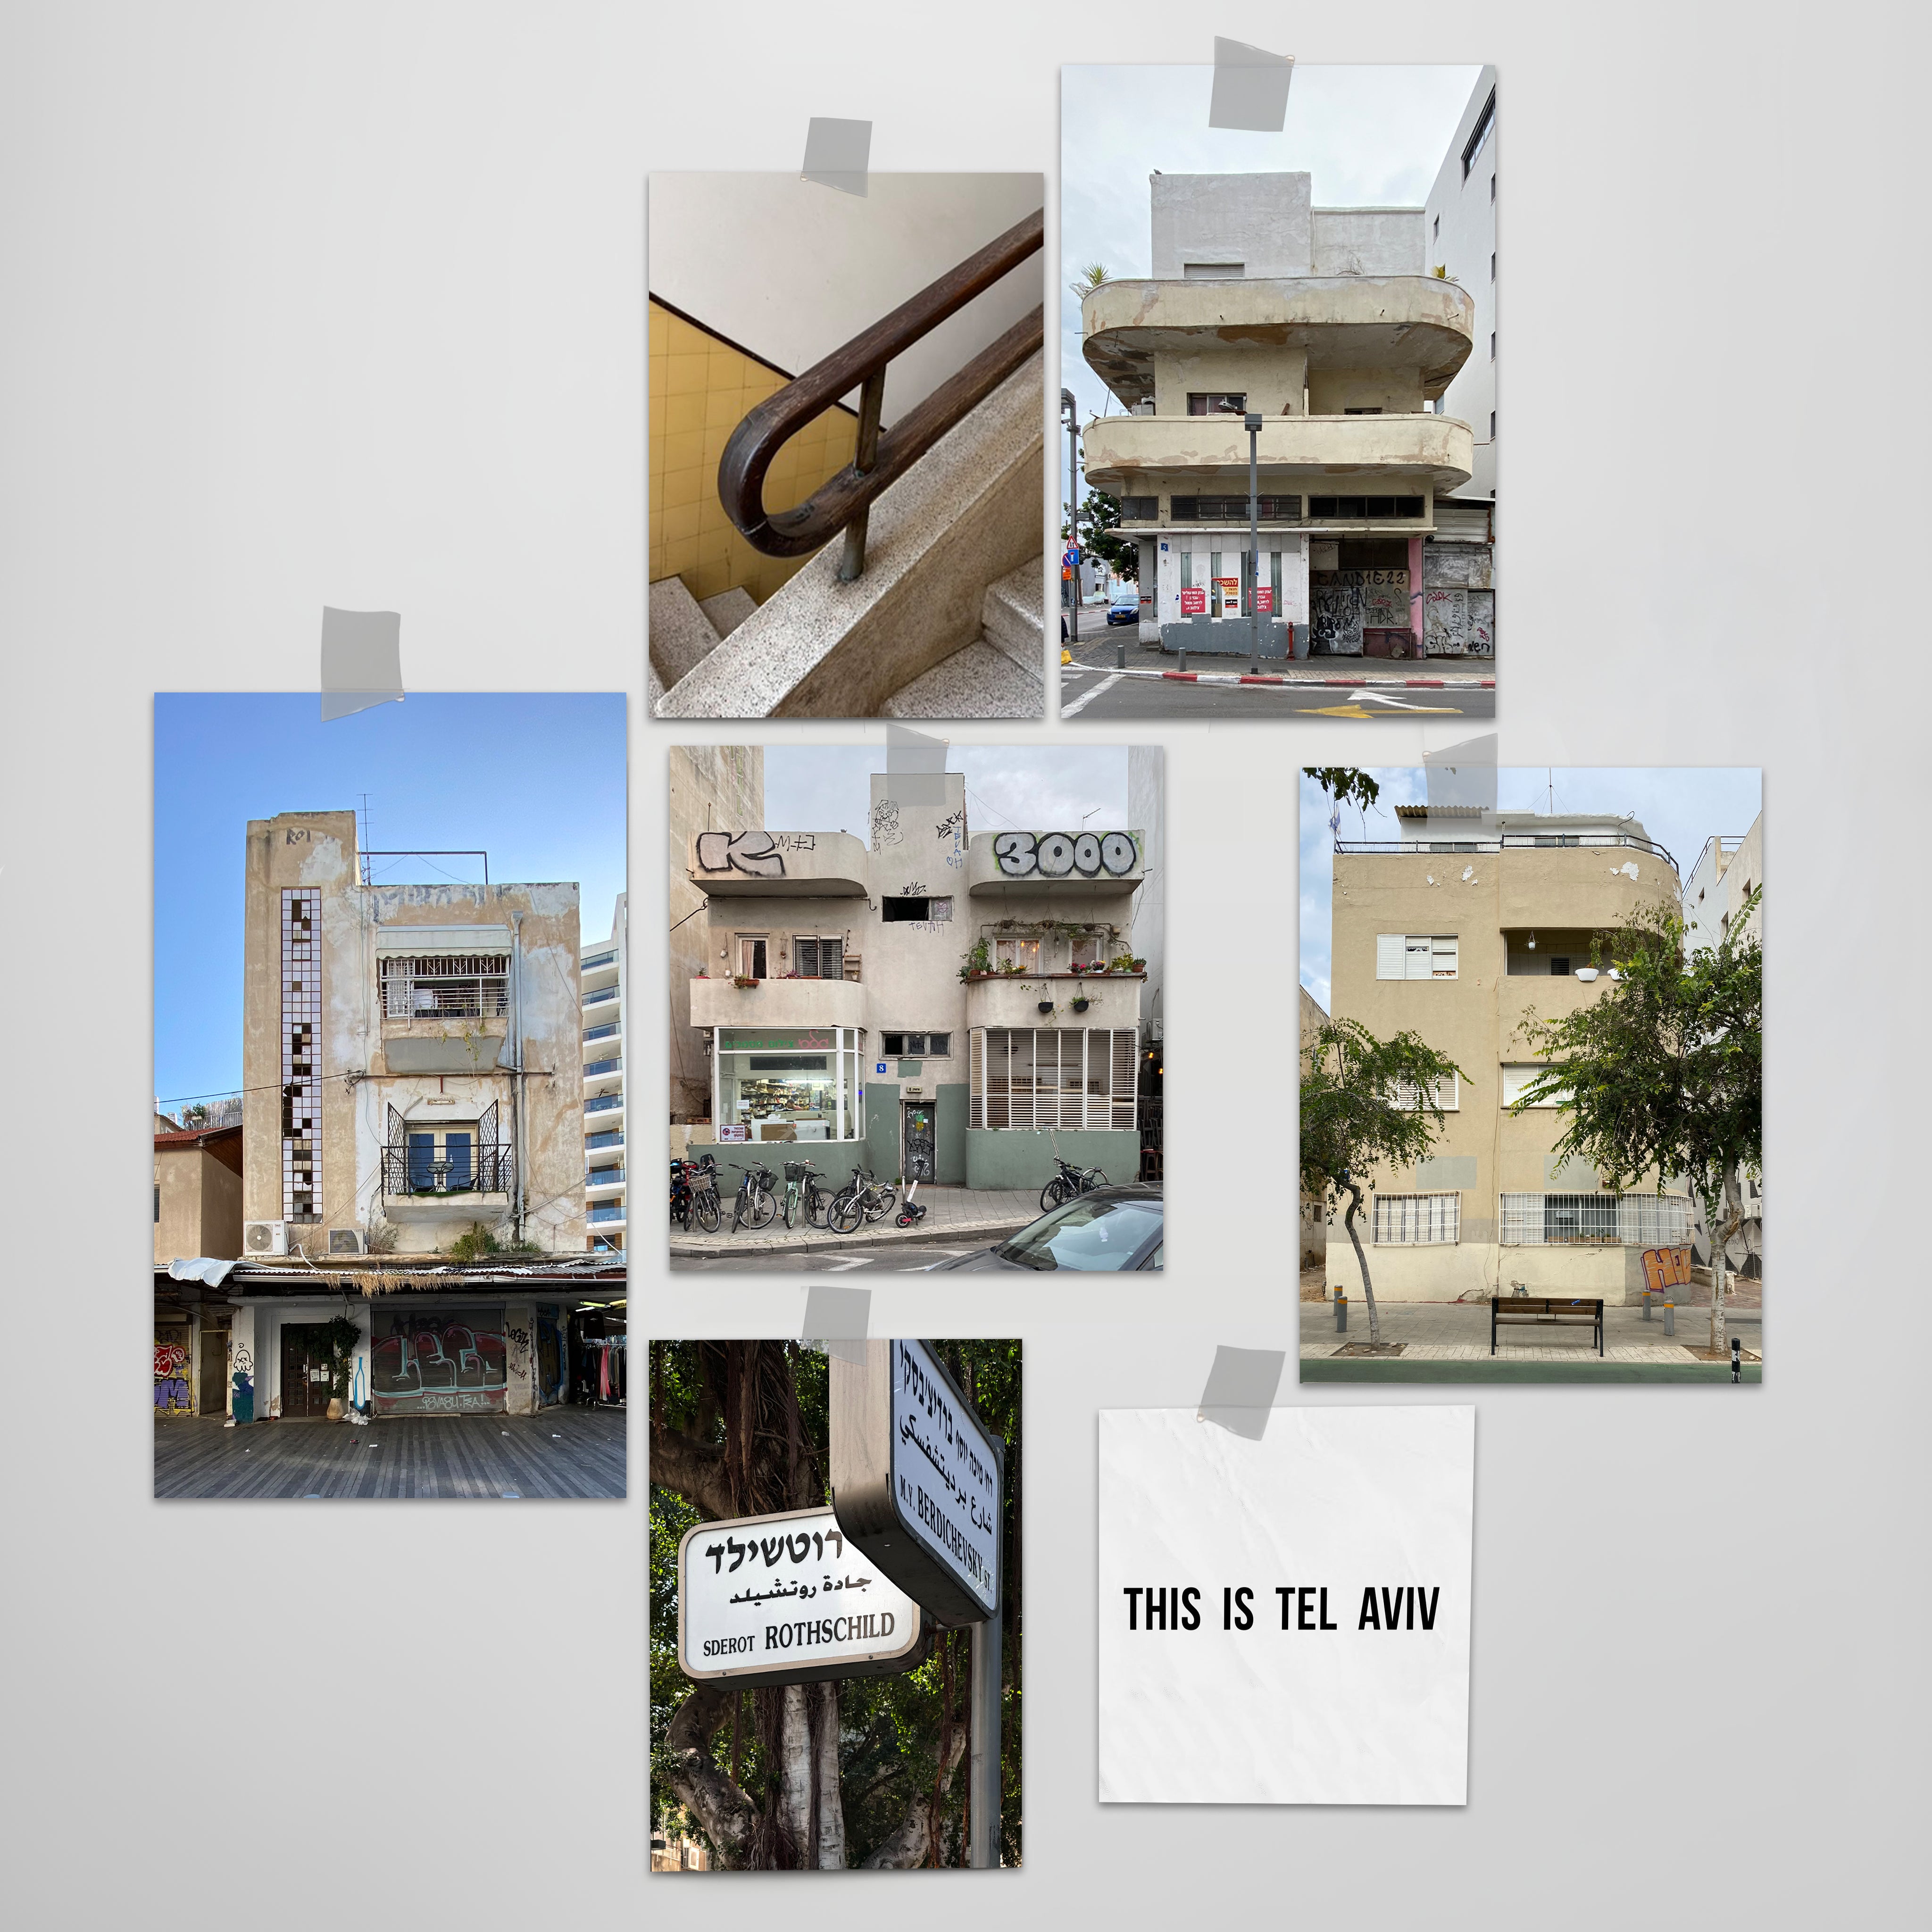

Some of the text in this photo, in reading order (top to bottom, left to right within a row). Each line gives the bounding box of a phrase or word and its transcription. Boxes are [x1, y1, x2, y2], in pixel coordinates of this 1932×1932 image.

[994, 832, 1137, 878] 3000
[725, 1040, 763, 1049] מסמכים
[768, 1039, 794, 1048] צילום
[956, 1429, 967, 1464] יוסף
[969, 1448, 983, 1485] מיכה
[900, 1474, 915, 1511] M.Y.
[917, 1484, 983, 1582] BERDICHEVSKY
[971, 1496, 992, 1535] شارع
[705, 1528, 843, 1574] רוטשילד
[729, 1574, 873, 1607] جادة روتشيلد
[1124, 1587, 1440, 1631] THIS IS TEL AVIV
[703, 1612, 895, 1657] SDEROT ROTHSCHILD
